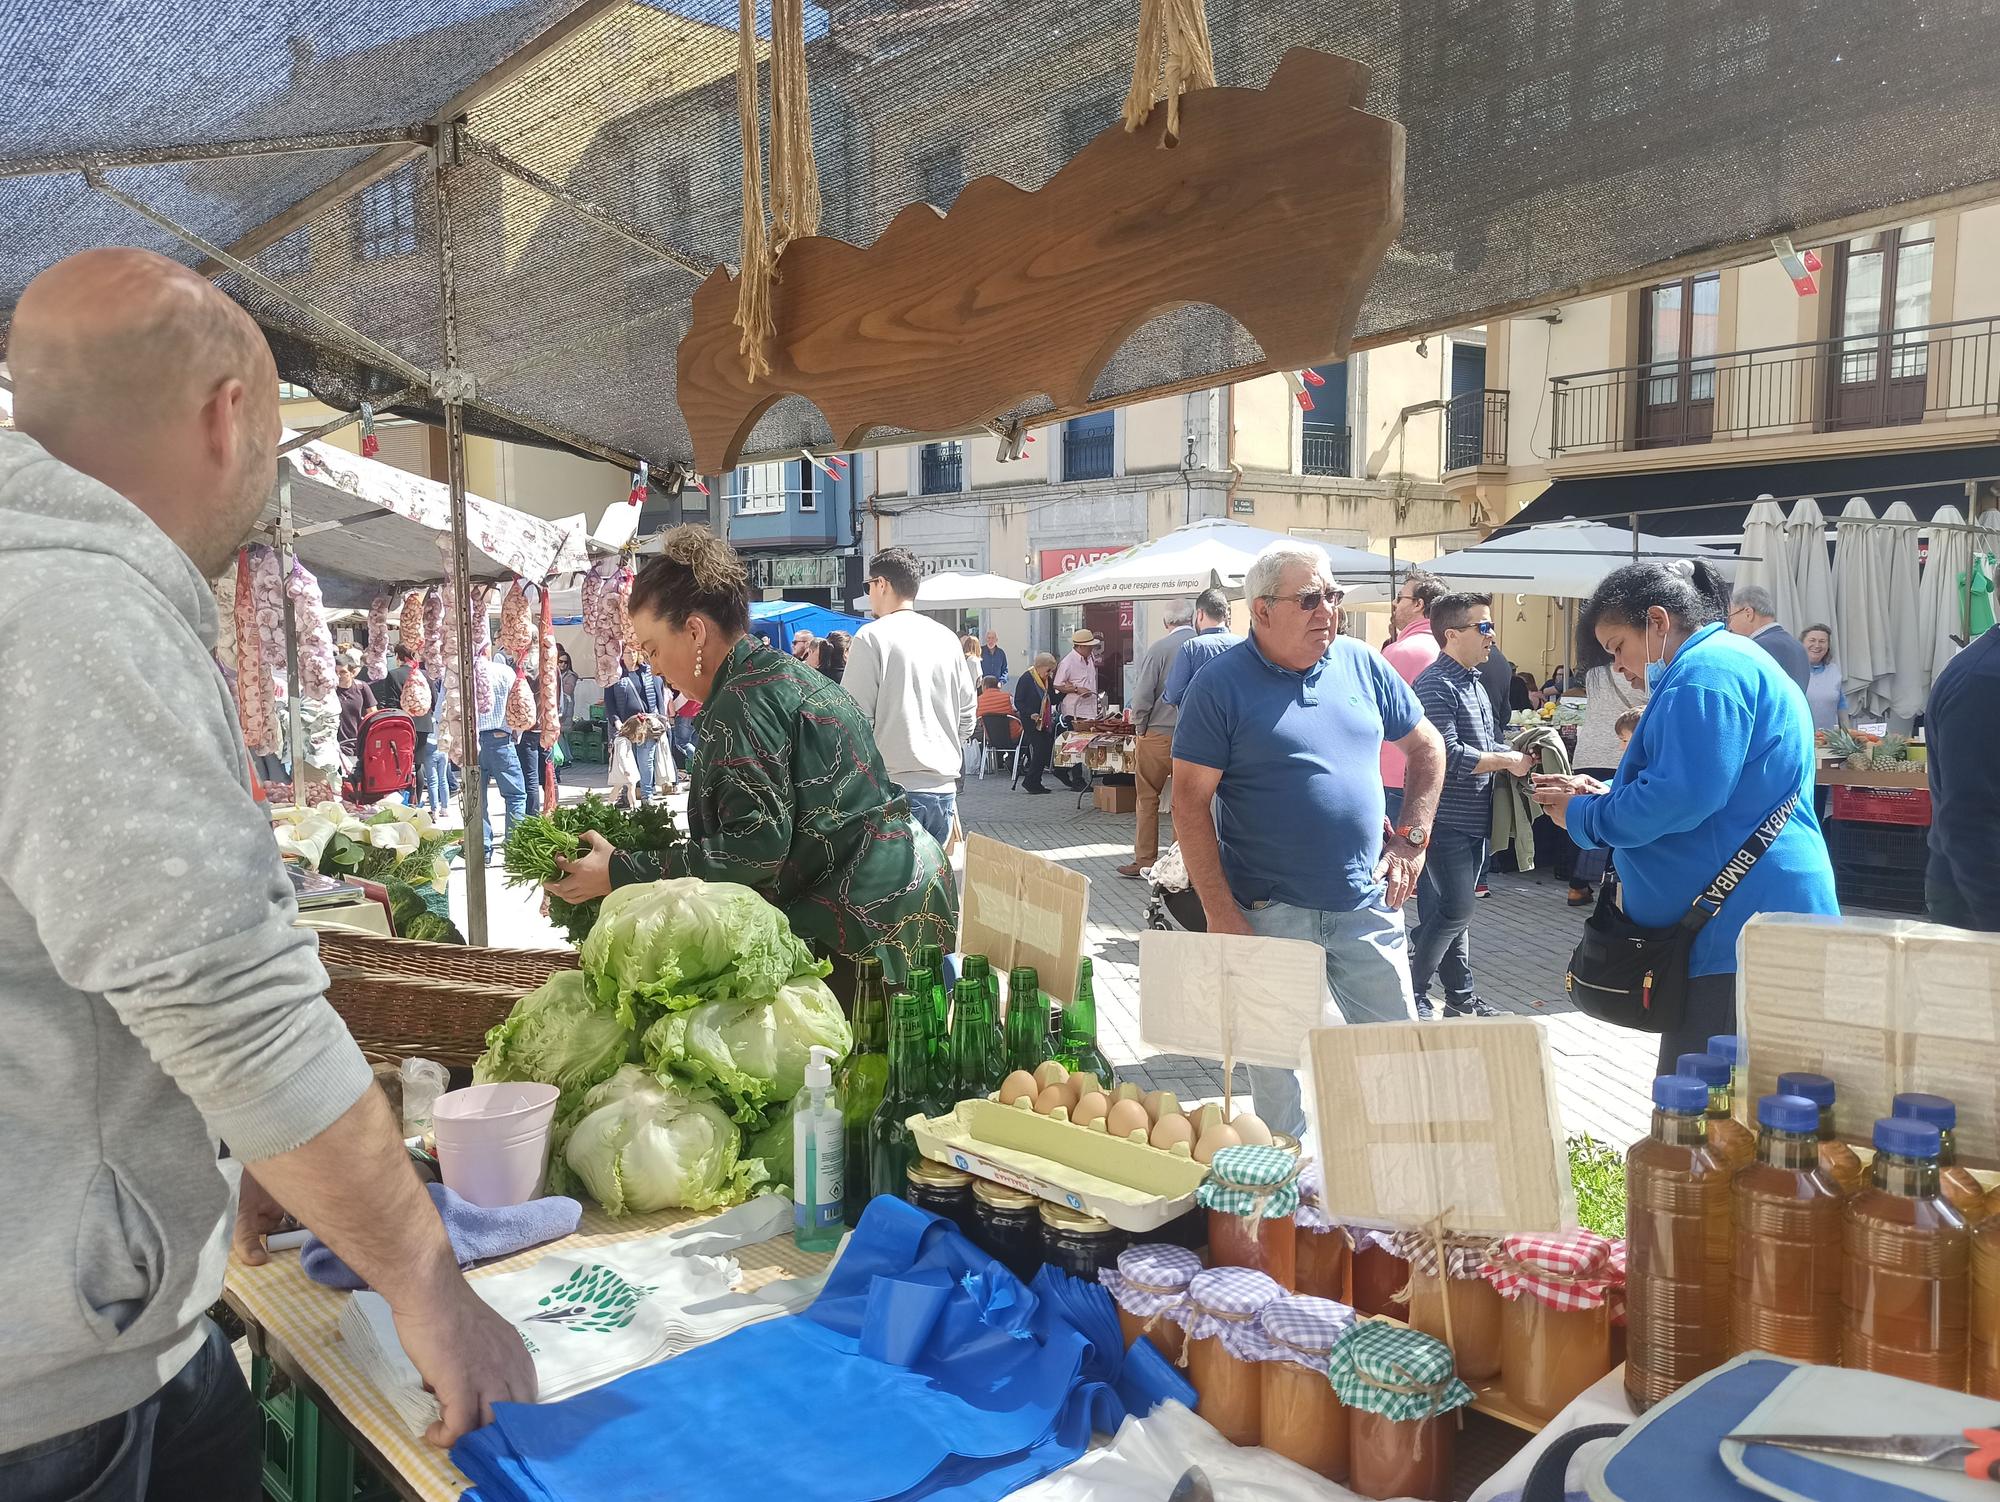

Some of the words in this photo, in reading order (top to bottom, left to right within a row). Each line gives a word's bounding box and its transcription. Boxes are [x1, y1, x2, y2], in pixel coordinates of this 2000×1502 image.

[1042, 592, 1055, 601] Este
[1055, 588, 1078, 600] parasol
[1078, 583, 1110, 595] contribuye
[1119, 582, 1132, 590] que
[1133, 581, 1160, 590] respires
[1161, 579, 1175, 588] más
[1176, 578, 1199, 589] limpio
